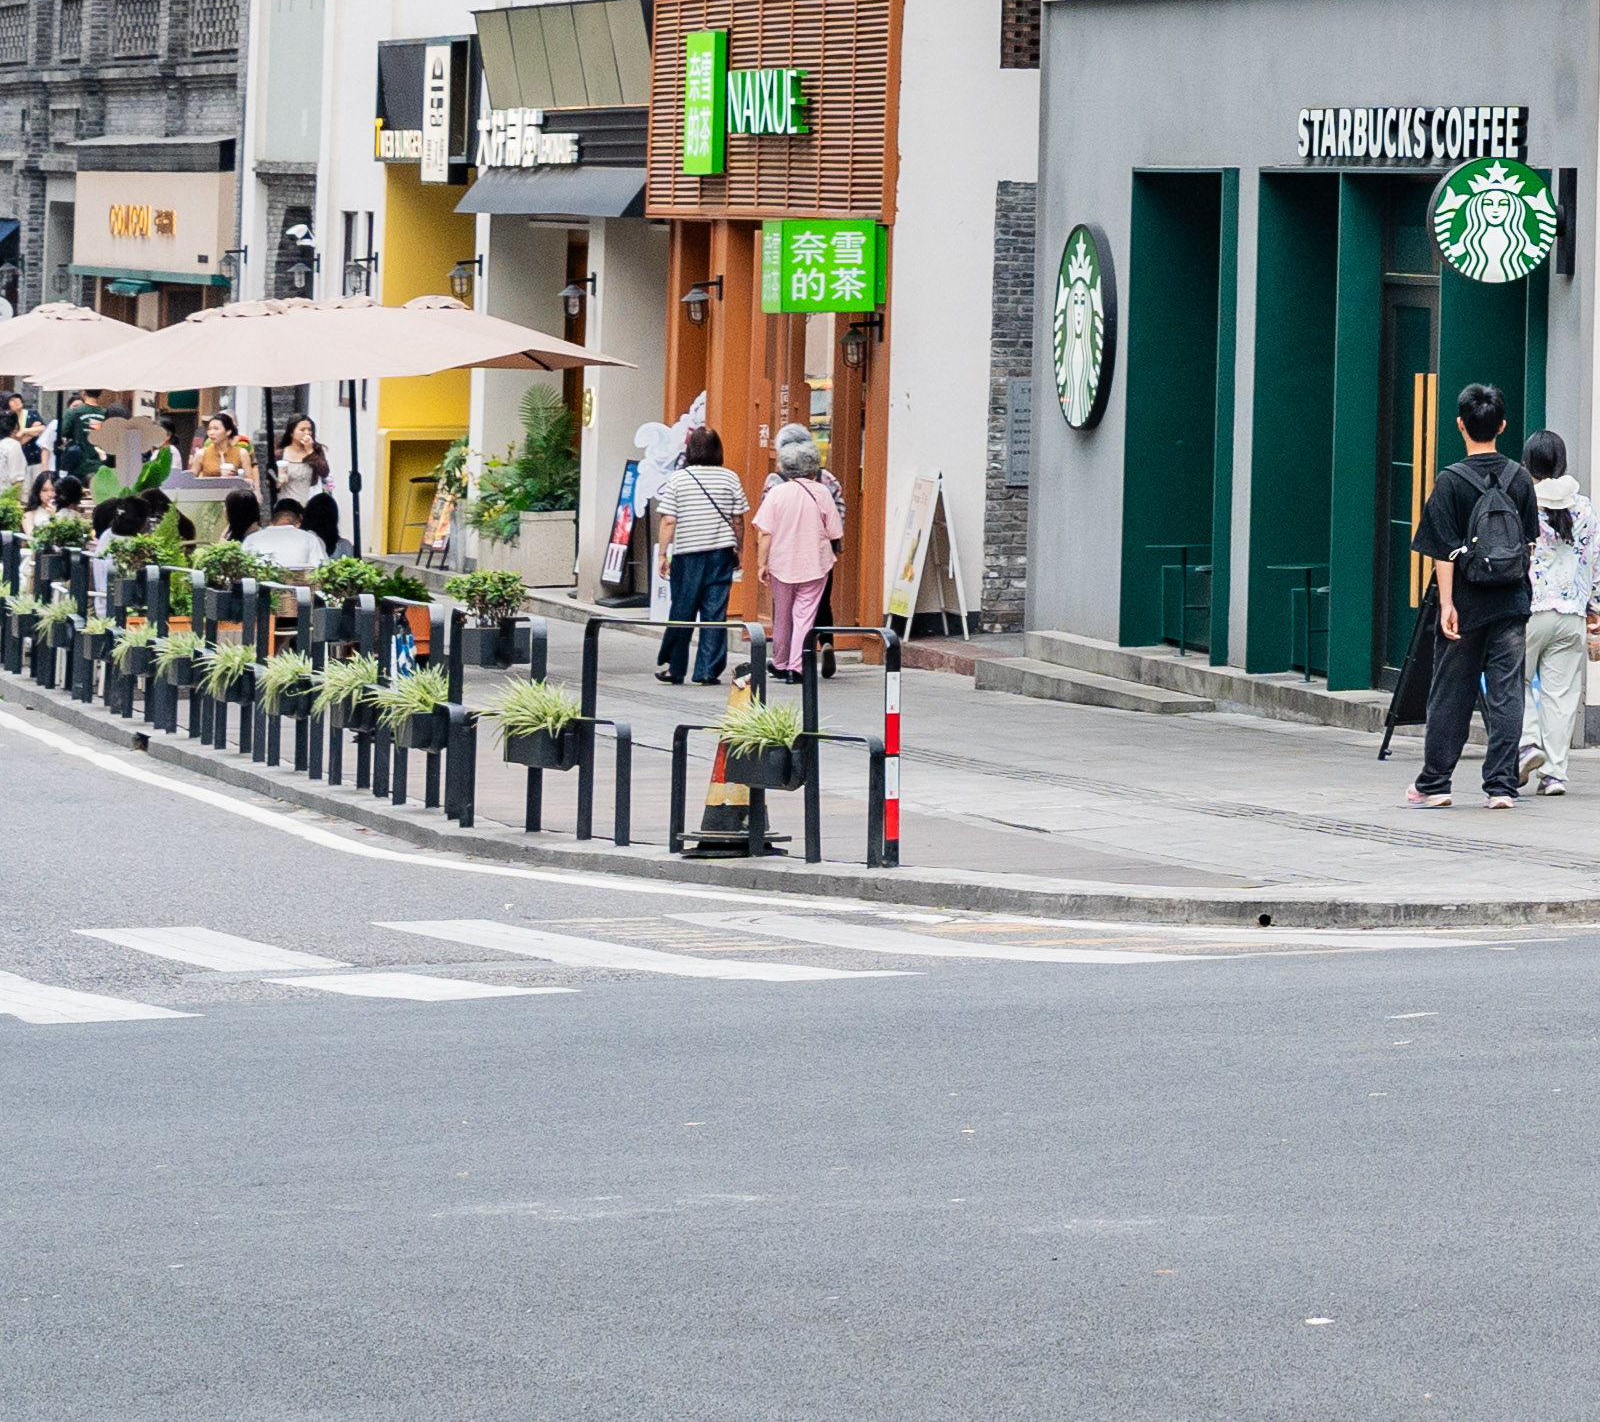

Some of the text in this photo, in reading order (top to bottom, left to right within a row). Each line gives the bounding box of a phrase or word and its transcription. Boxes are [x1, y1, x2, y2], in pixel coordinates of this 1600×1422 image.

[727, 69, 799, 134] NAIXUE
[1297, 106, 1521, 159] STARBUCKS COFFEE
[790, 231, 867, 266] 奈雪
[791, 267, 867, 302] 的茶
